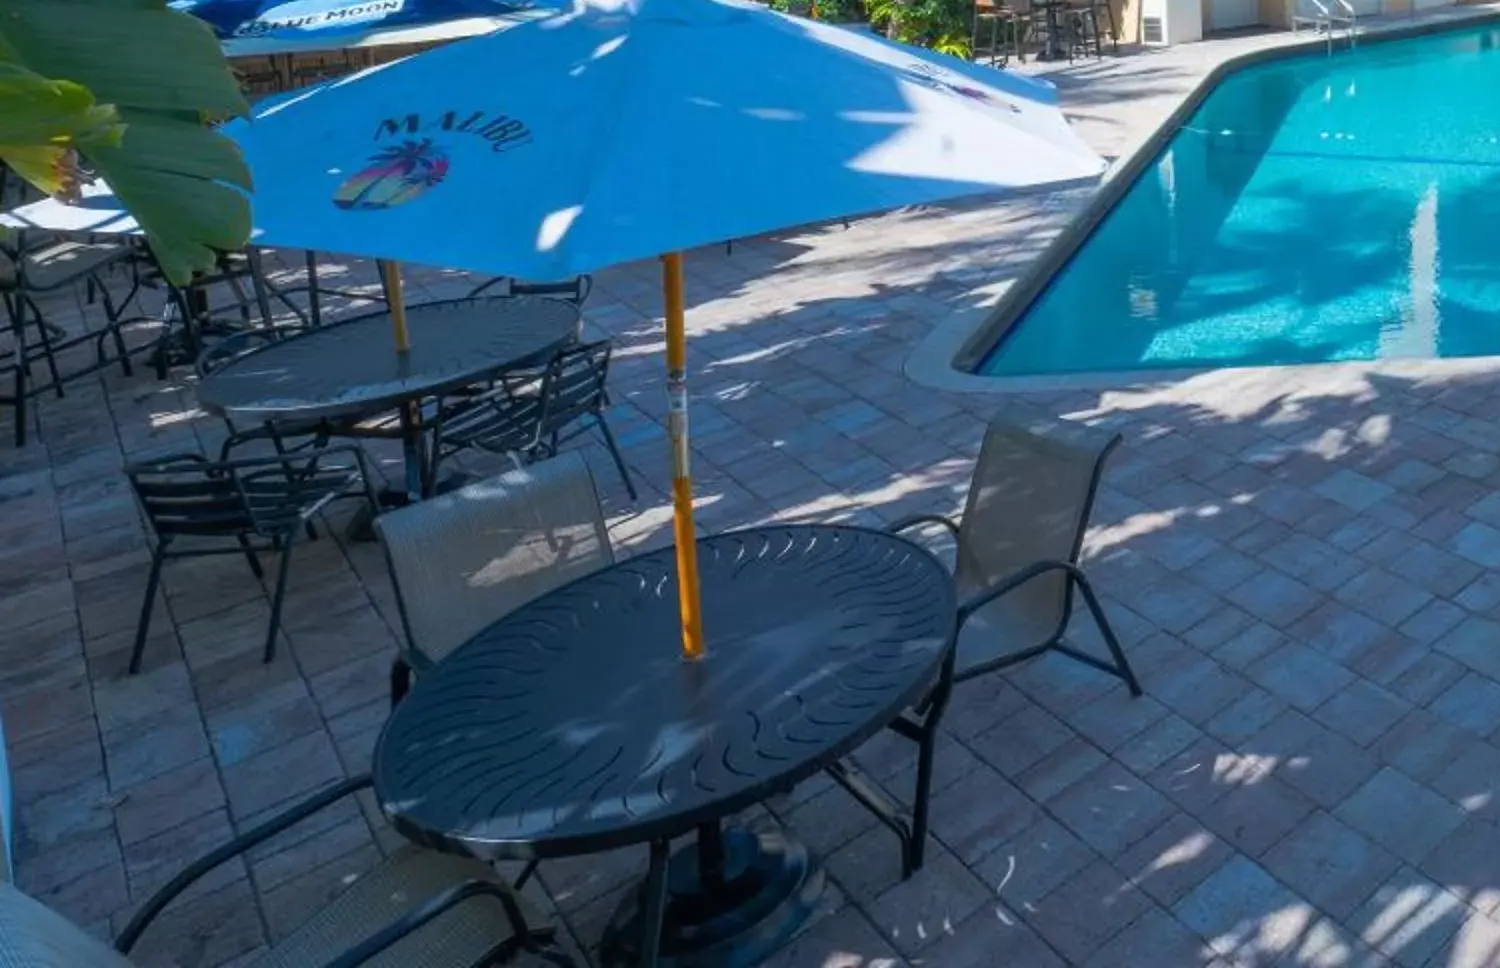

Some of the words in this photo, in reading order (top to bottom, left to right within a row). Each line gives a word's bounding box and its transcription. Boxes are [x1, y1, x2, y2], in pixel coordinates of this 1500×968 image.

[242, 13, 320, 35] BLUE
[325, 0, 400, 21] MOON
[372, 110, 535, 153] MALIBU
